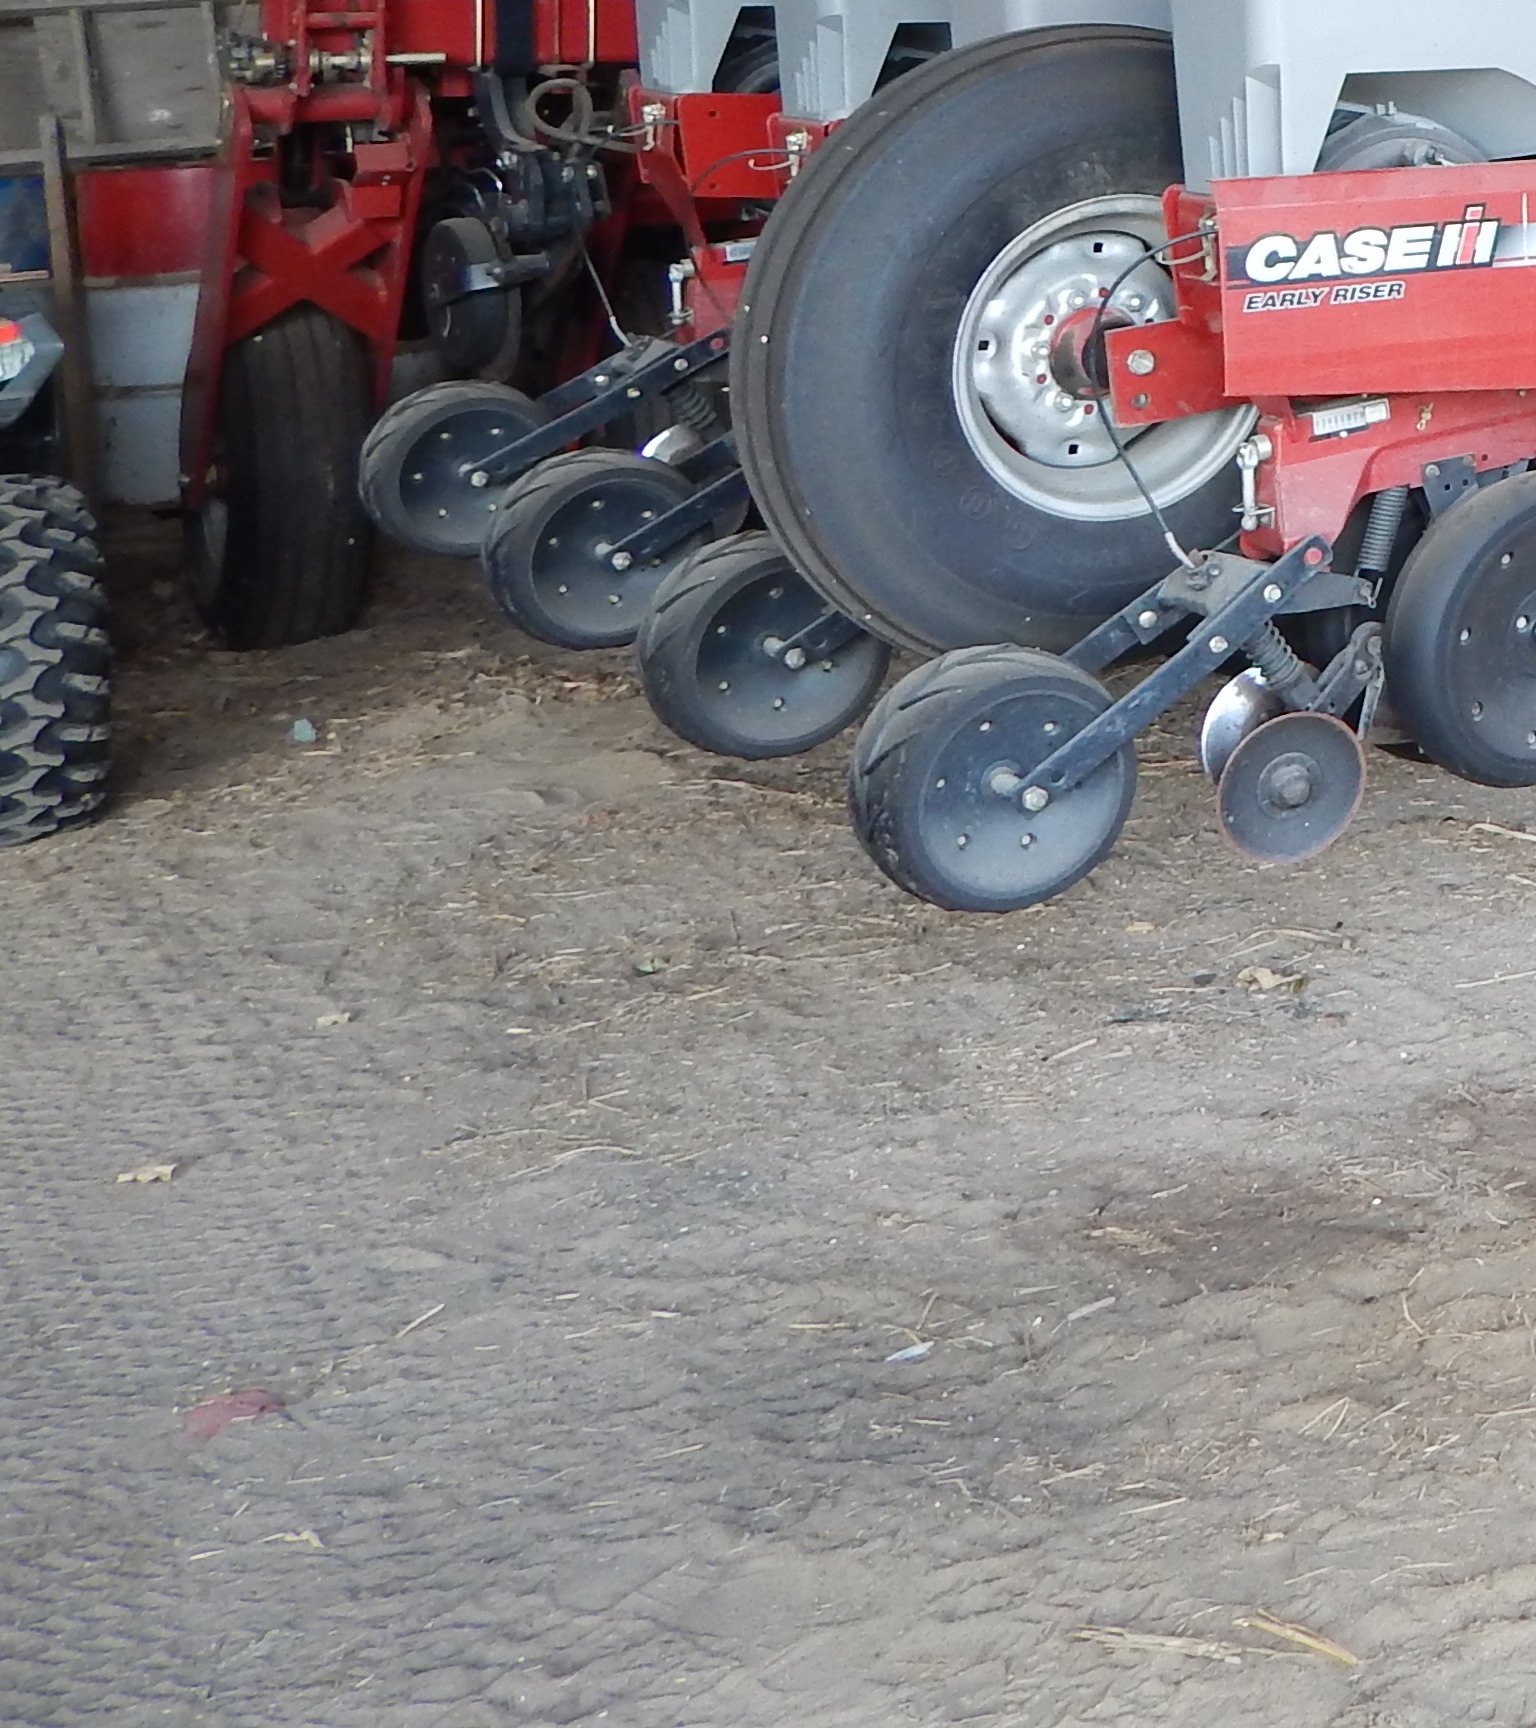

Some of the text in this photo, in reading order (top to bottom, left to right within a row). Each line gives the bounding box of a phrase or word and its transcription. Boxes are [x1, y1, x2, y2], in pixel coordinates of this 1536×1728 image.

[1245, 225, 1434, 283] CASE
[1245, 282, 1404, 311] EARLY RISER
